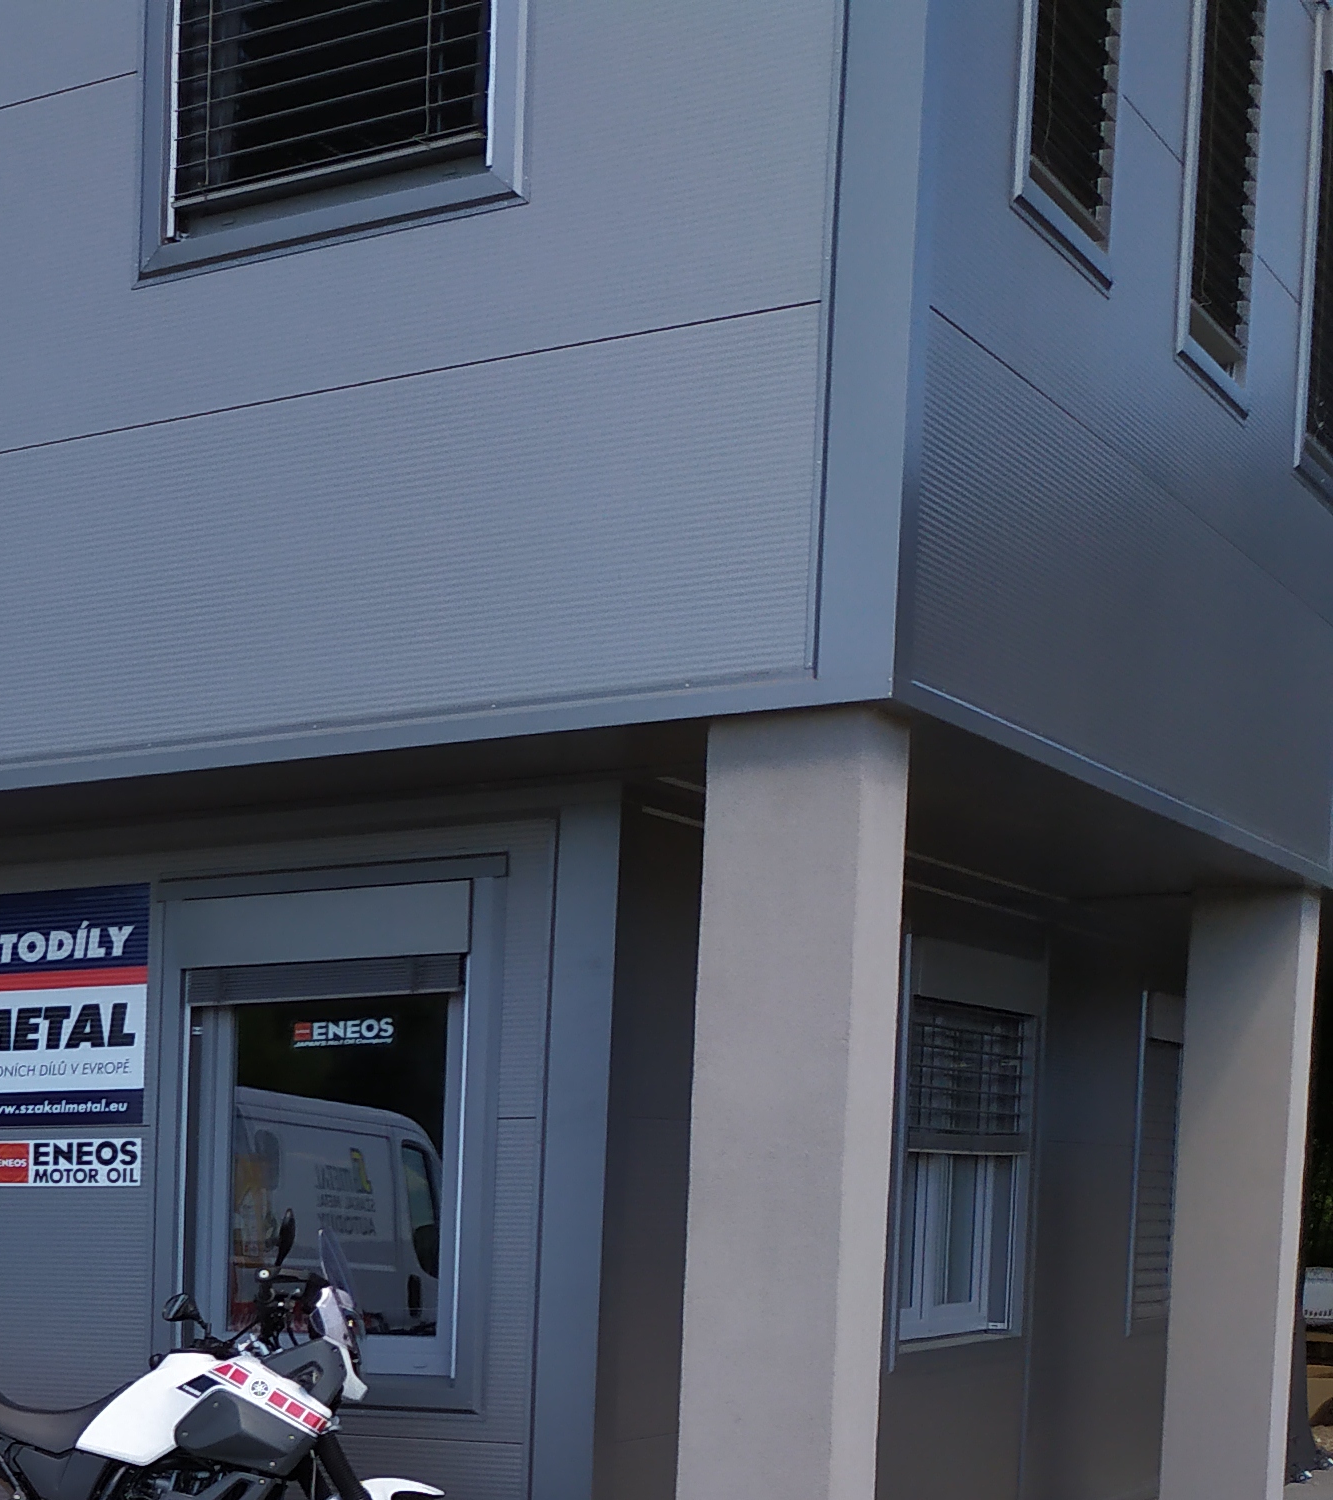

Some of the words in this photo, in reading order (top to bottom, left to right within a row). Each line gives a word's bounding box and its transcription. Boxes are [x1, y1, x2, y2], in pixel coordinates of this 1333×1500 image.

[312, 1017, 394, 1040] ENEOS
[39, 1060, 67, 1077] DÍLŮ
[71, 1063, 79, 1075] V
[33, 1141, 138, 1166] ENEOS
[33, 1168, 99, 1184] MOTOR
[106, 1168, 138, 1184] OIL
